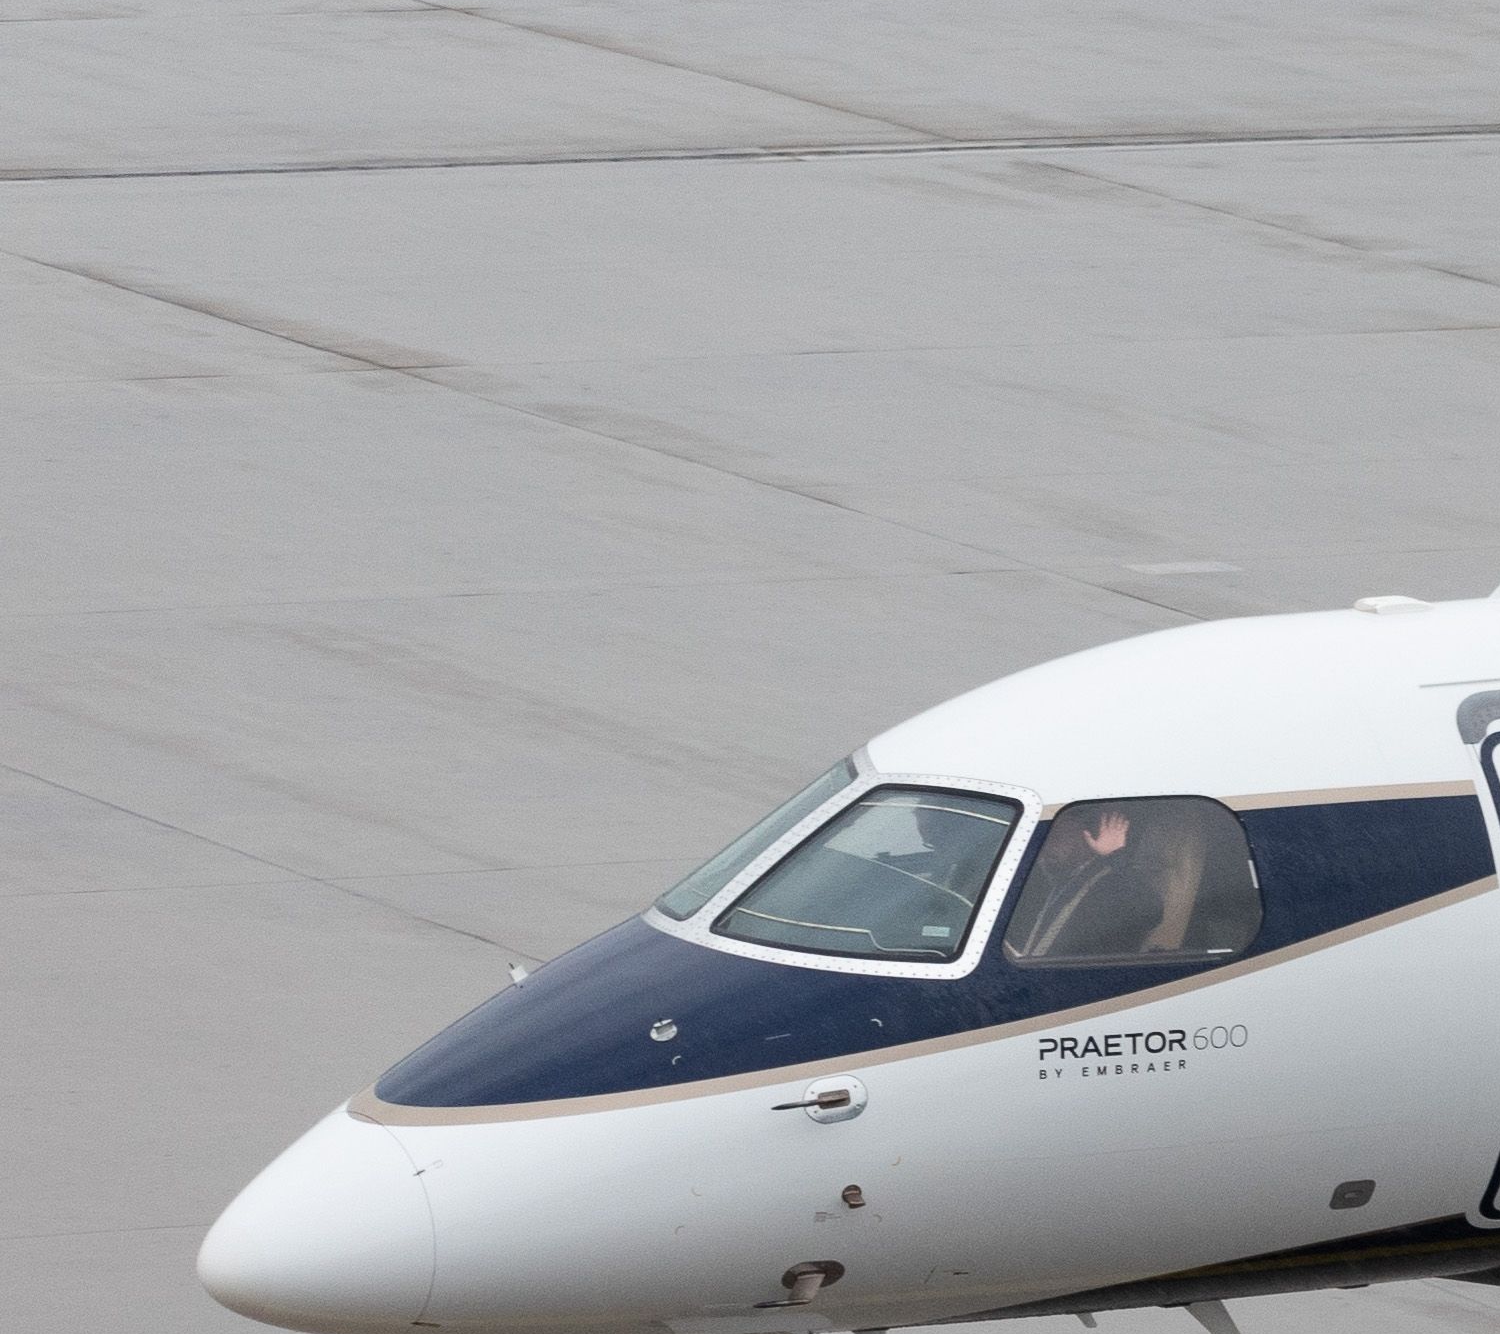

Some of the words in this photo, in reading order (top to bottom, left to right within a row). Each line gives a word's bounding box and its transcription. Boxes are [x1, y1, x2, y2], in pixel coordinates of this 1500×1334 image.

[1038, 1029, 1188, 1062] PRAETOR
[1192, 1024, 1249, 1051] 600
[1038, 1067, 1063, 1080] BY
[1081, 1059, 1188, 1078] EMBRAER
